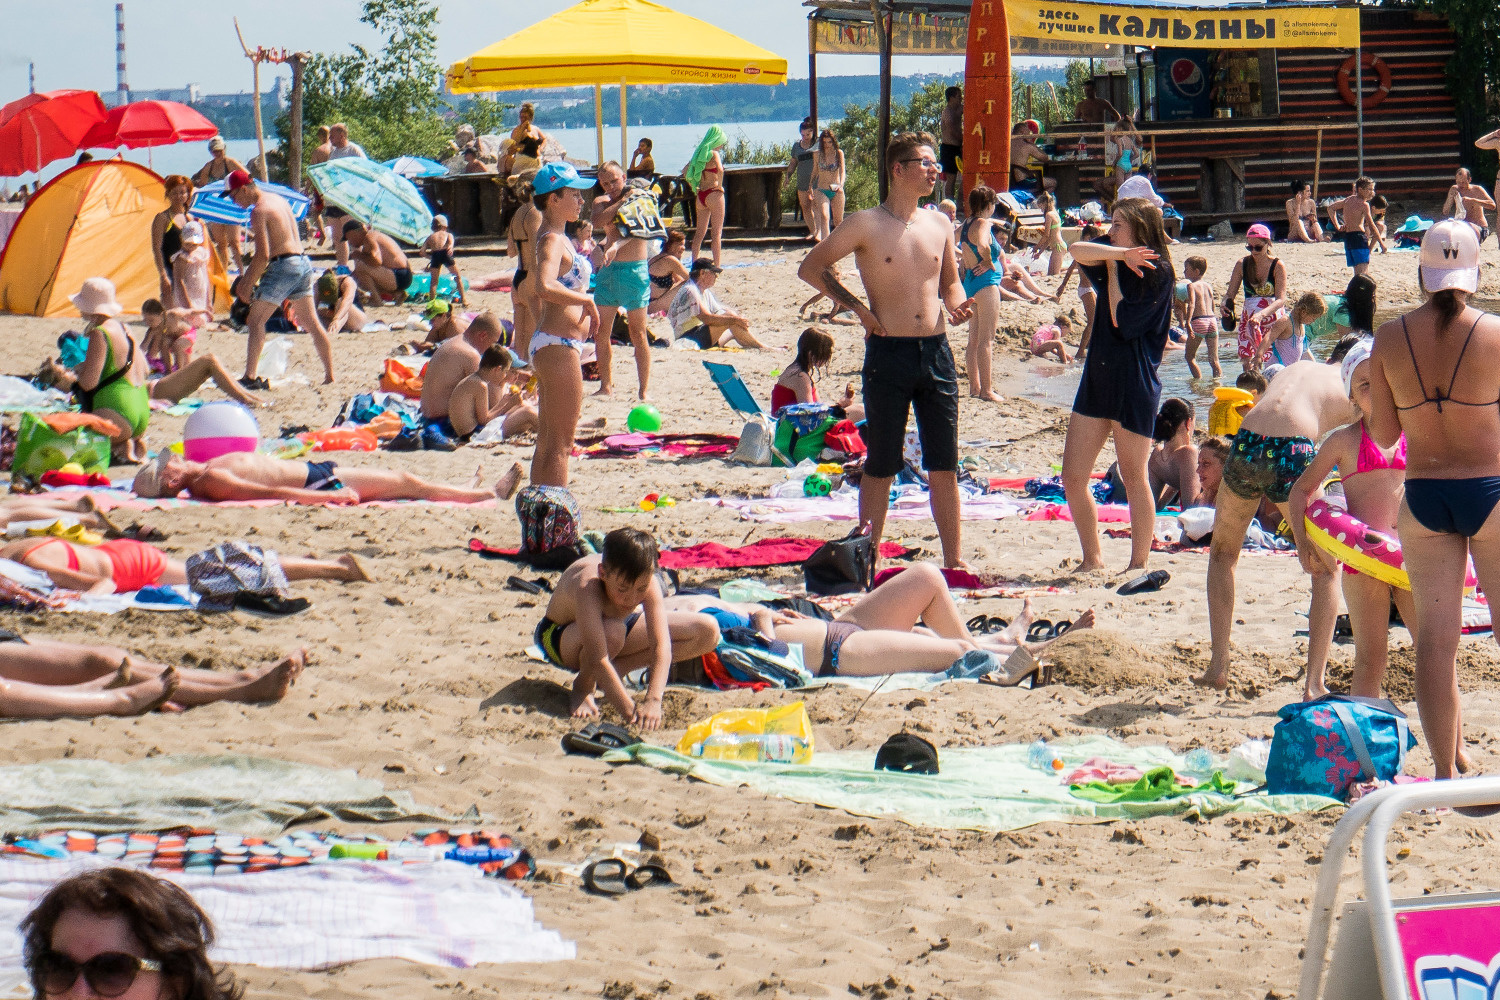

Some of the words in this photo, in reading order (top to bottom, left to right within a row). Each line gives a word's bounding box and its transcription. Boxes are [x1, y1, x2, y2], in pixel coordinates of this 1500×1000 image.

[1038, 9, 1080, 20] здесь
[1038, 21, 1095, 34] лучшие
[670, 68, 709, 78] ОТКРОЙСЯ
